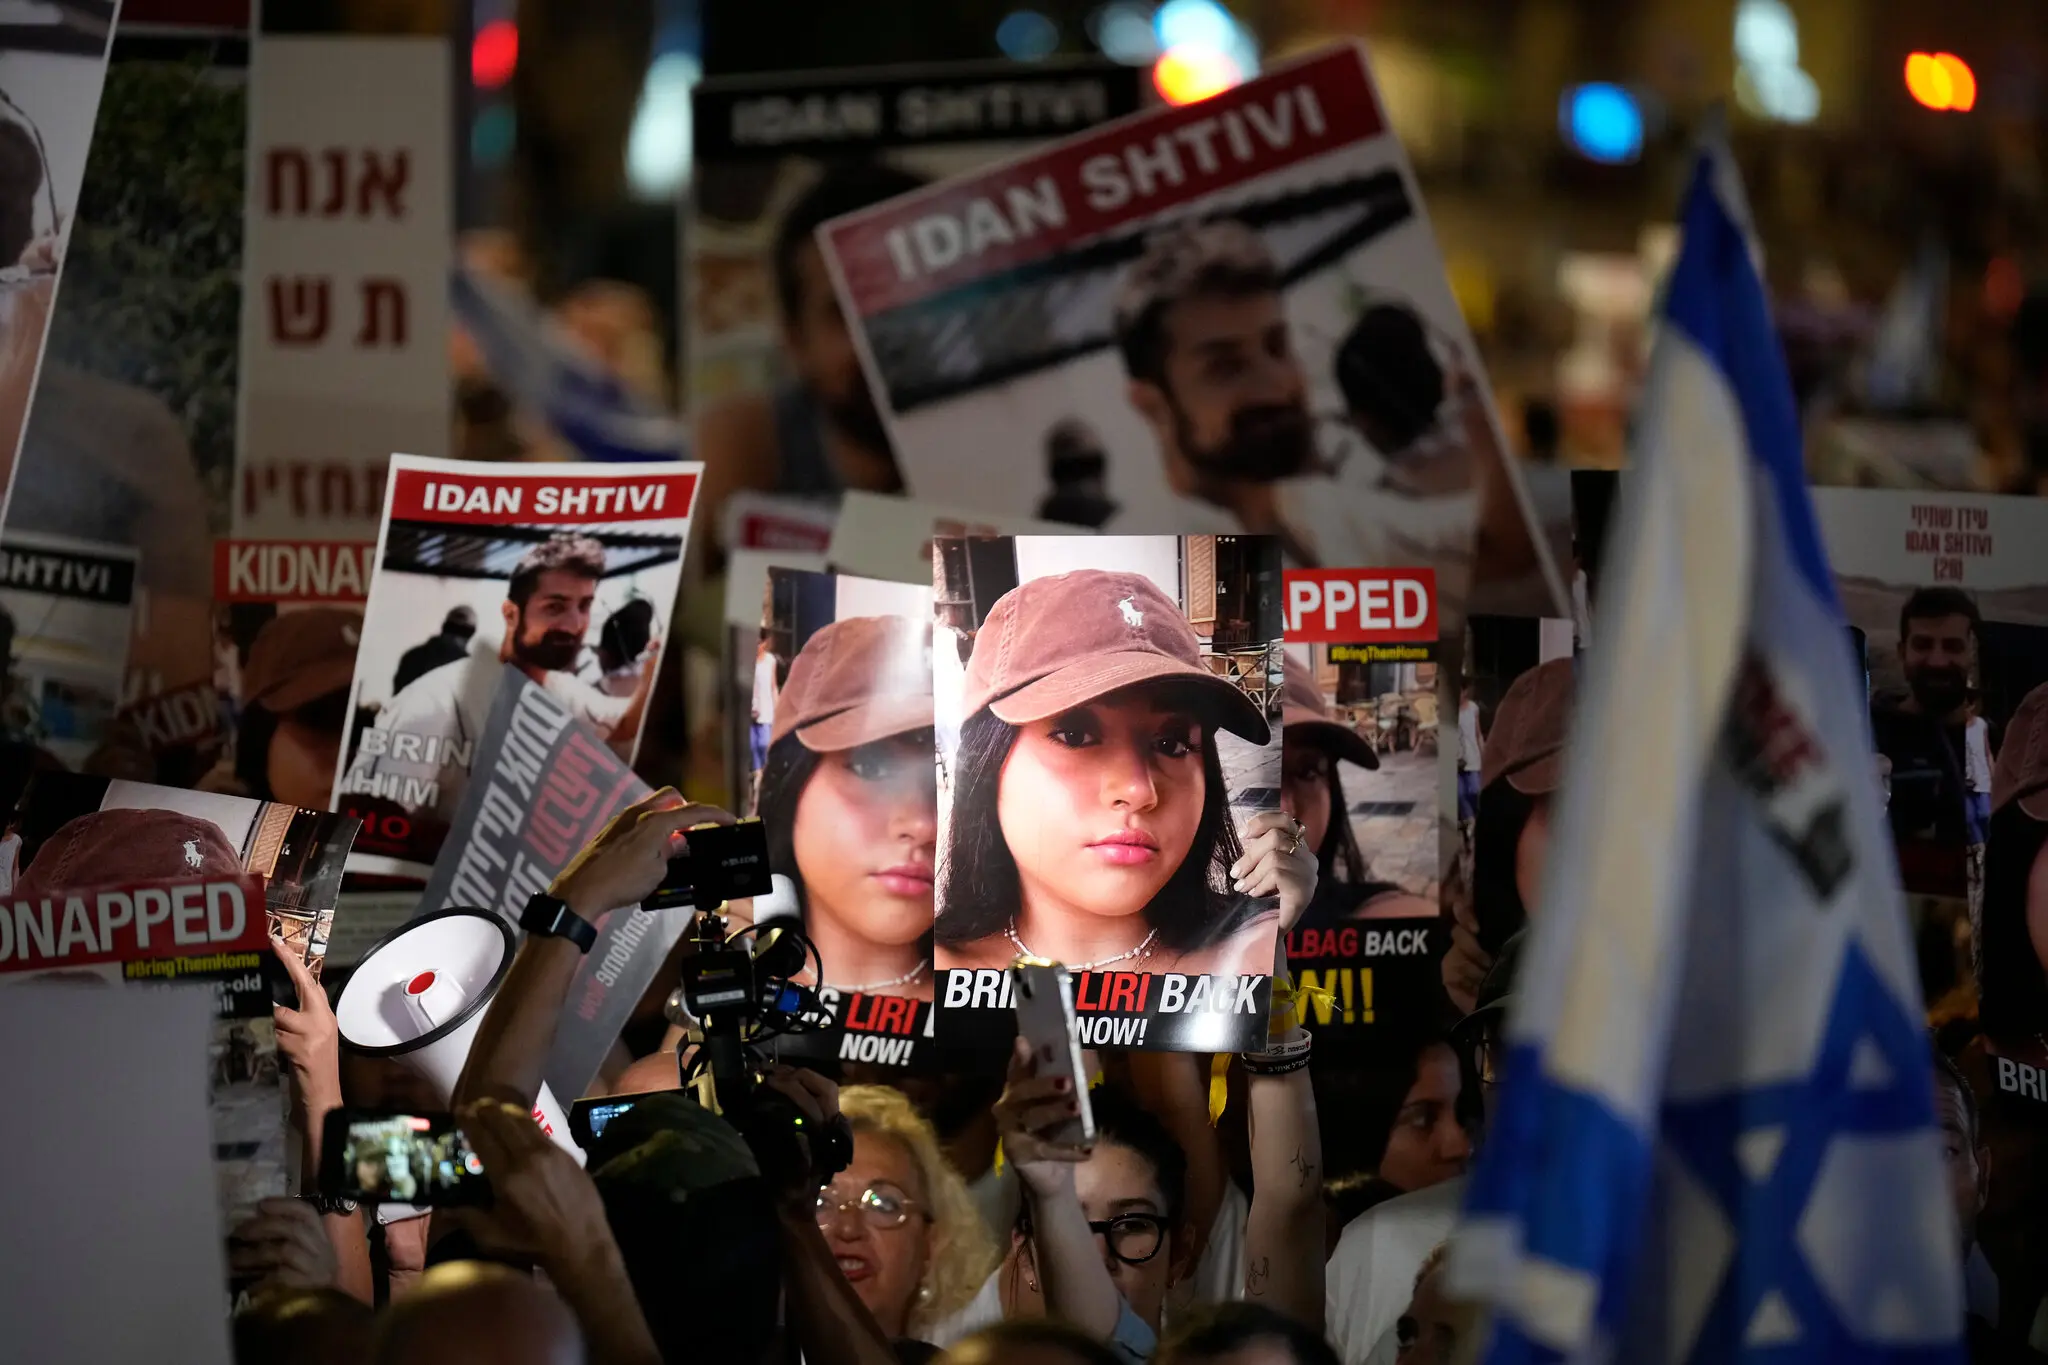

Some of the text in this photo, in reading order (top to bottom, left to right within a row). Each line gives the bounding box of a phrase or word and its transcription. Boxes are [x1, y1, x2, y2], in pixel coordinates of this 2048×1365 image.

[885, 84, 1327, 279] IDAN SHTIVI
[422, 482, 667, 515] IDAN SHTIVI
[1905, 530, 1992, 556] IDAN SHTIVI
[1282, 579, 1428, 632] PPED
[353, 768, 438, 808] HIM
[1286, 928, 1430, 960] LBAG BACK
[126, 953, 260, 979] #BringThemHome
[943, 969, 1264, 1015] BRI LIRI BACK
[1288, 967, 1376, 1026] W!!
[844, 992, 920, 1036] LIRI
[1075, 1016, 1158, 1047] NOW!
[838, 1032, 915, 1067] NOW!
